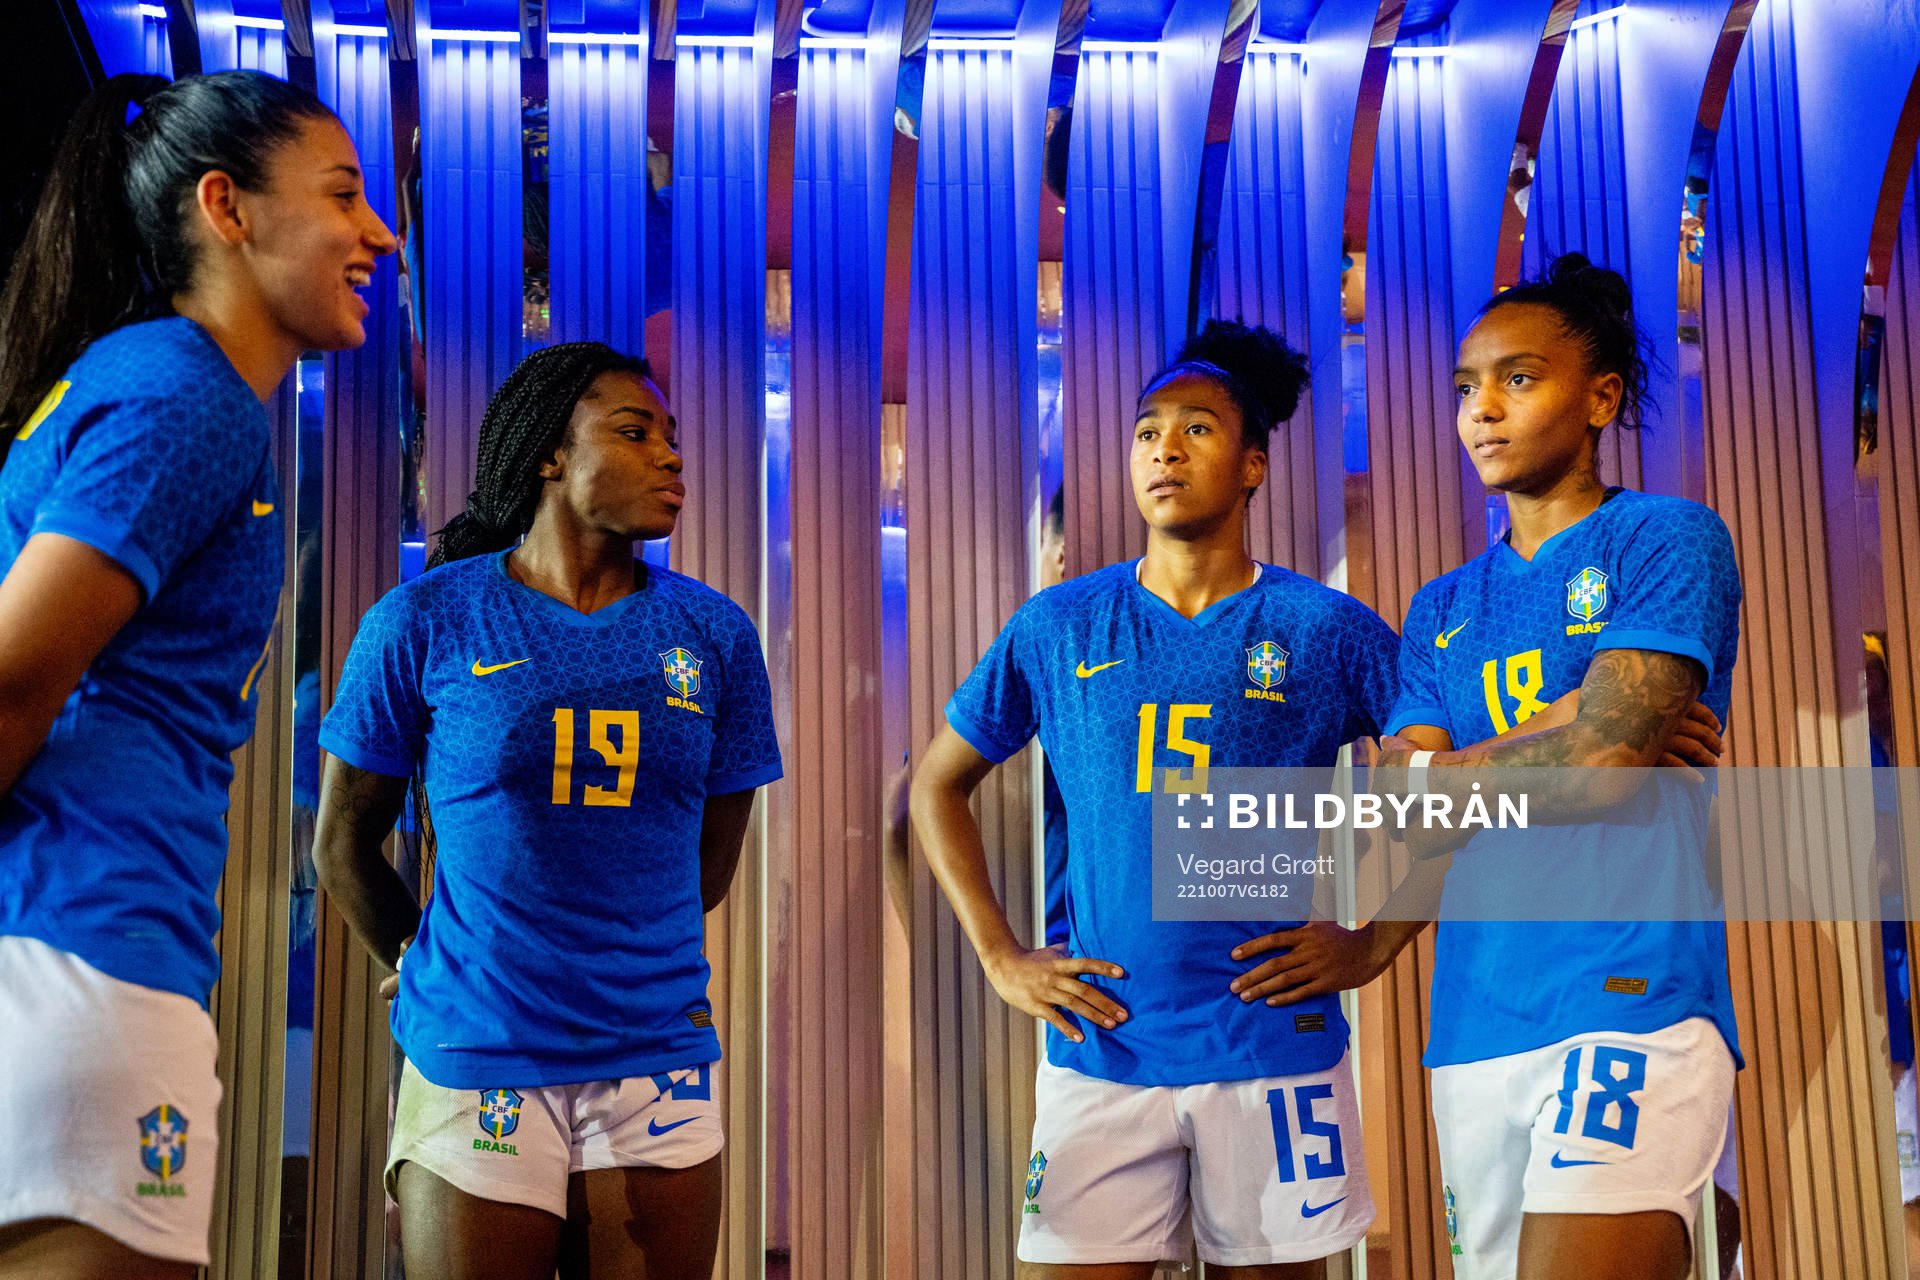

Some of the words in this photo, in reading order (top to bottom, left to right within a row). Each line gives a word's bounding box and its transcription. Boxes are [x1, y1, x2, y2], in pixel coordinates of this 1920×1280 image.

[1579, 587, 1593, 596] CBF
[1566, 622, 1609, 636] BRAS
[1245, 688, 1286, 703] BRASIL
[1481, 649, 1550, 736] 18
[666, 696, 704, 714] BRASIL
[551, 708, 640, 807] 19
[1136, 703, 1213, 795] 15
[1553, 1046, 1647, 1150] 18
[492, 1105, 509, 1113] CBF
[1266, 1083, 1346, 1183] 15
[473, 1138, 519, 1156] BRASIL
